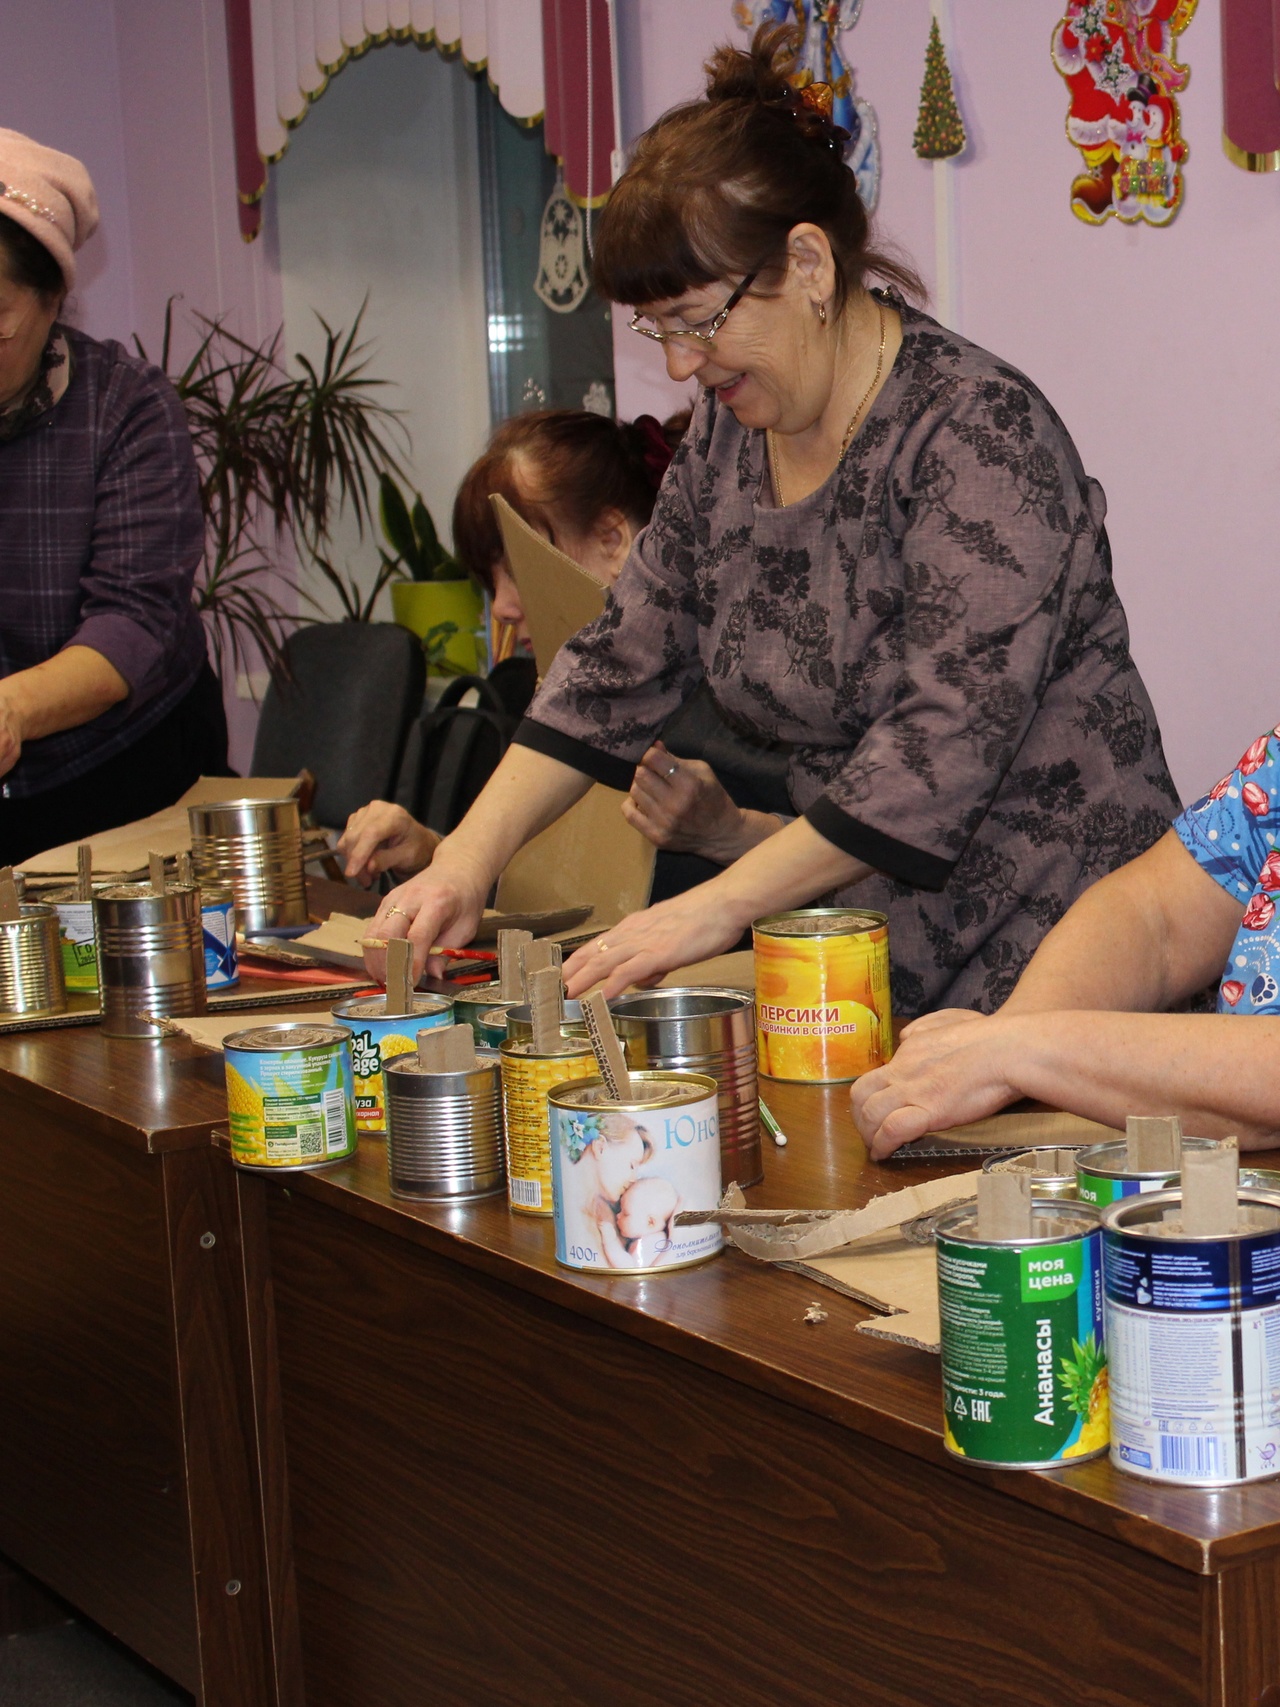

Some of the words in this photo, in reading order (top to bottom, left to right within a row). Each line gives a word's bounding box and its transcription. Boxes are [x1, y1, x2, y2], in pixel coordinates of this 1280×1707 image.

[760, 1004, 839, 1023] ПЕРСИКИ
[802, 1027, 809, 1035] В
[812, 1024, 856, 1035] СИРОПЕ
[569, 1245, 599, 1262] 400г
[1028, 1258, 1064, 1273] моя
[1029, 1273, 1074, 1290] цена
[1094, 1269, 1102, 1322] кусочки
[1034, 1318, 1055, 1426] Ананасы
